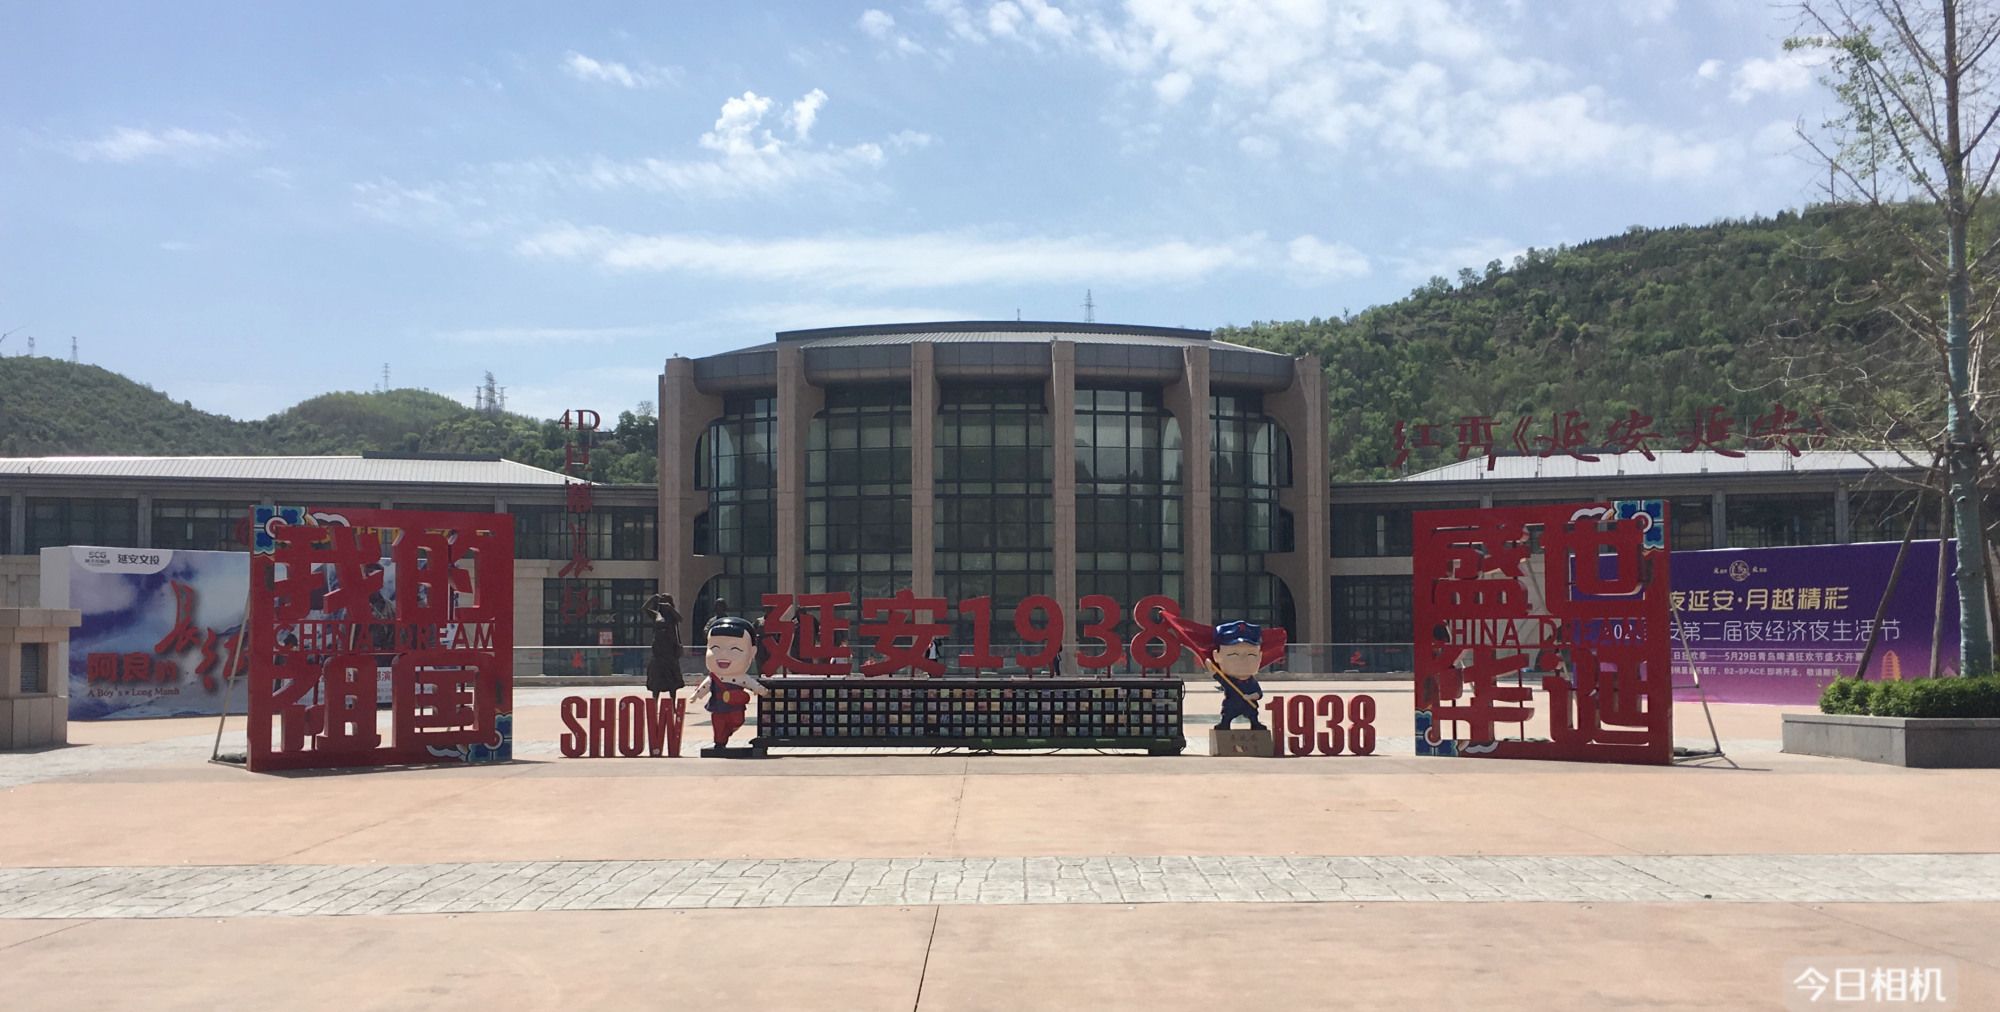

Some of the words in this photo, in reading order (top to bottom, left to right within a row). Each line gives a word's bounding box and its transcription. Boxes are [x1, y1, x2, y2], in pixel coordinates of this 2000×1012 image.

[272, 524, 496, 622] 我的
[1431, 522, 1650, 615] 盛世
[273, 623, 373, 650] CHINA
[394, 623, 494, 650] DREAM
[761, 588, 1182, 677] 延安1938
[270, 650, 496, 750] 祖国
[560, 695, 687, 758] SHOW
[1265, 694, 1376, 757] 1938
[1430, 647, 1650, 747] 华诞
